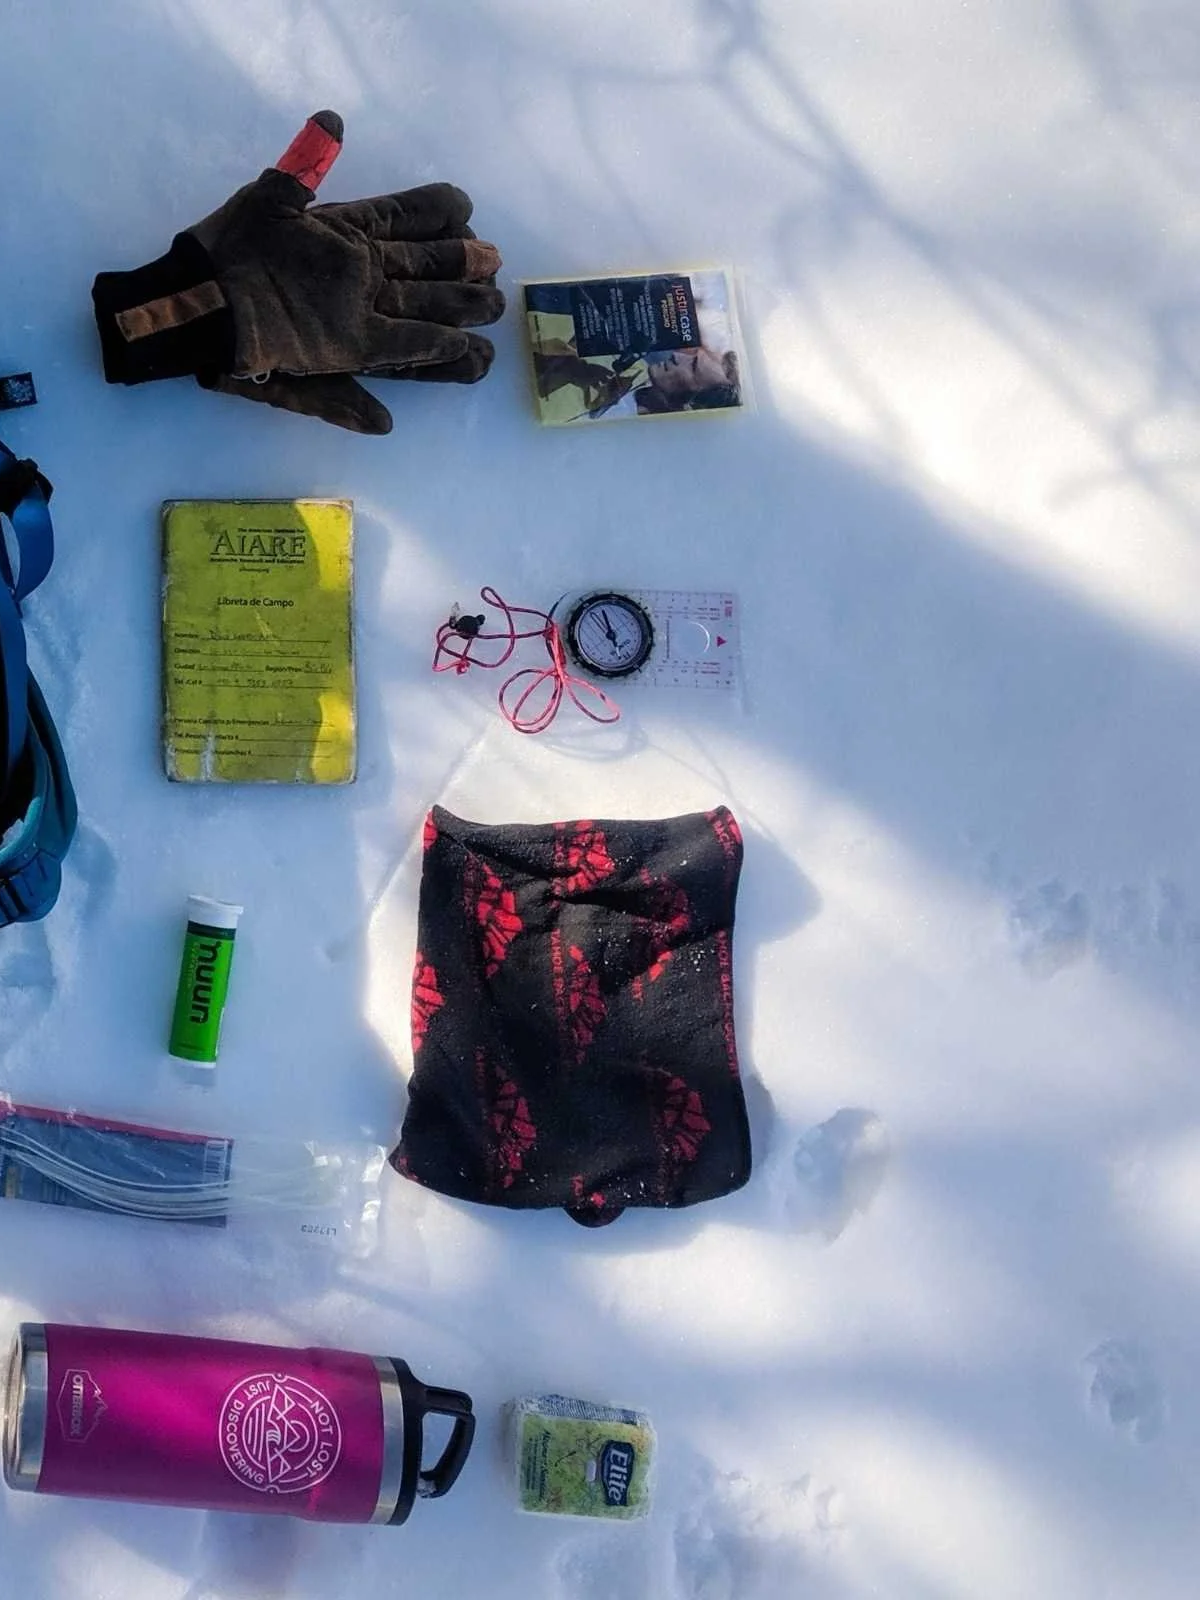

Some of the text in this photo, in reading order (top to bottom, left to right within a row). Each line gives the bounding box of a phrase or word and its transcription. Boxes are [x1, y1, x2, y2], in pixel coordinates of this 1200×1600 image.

[210, 530, 306, 557] AIARE
[217, 596, 295, 608] Libreta de Campo
[551, 928, 564, 974] TAHOE
[226, 1380, 271, 1484] JUST DISCOVERING
[306, 1400, 334, 1478] NOT LOST
[608, 1448, 629, 1505] Elite
